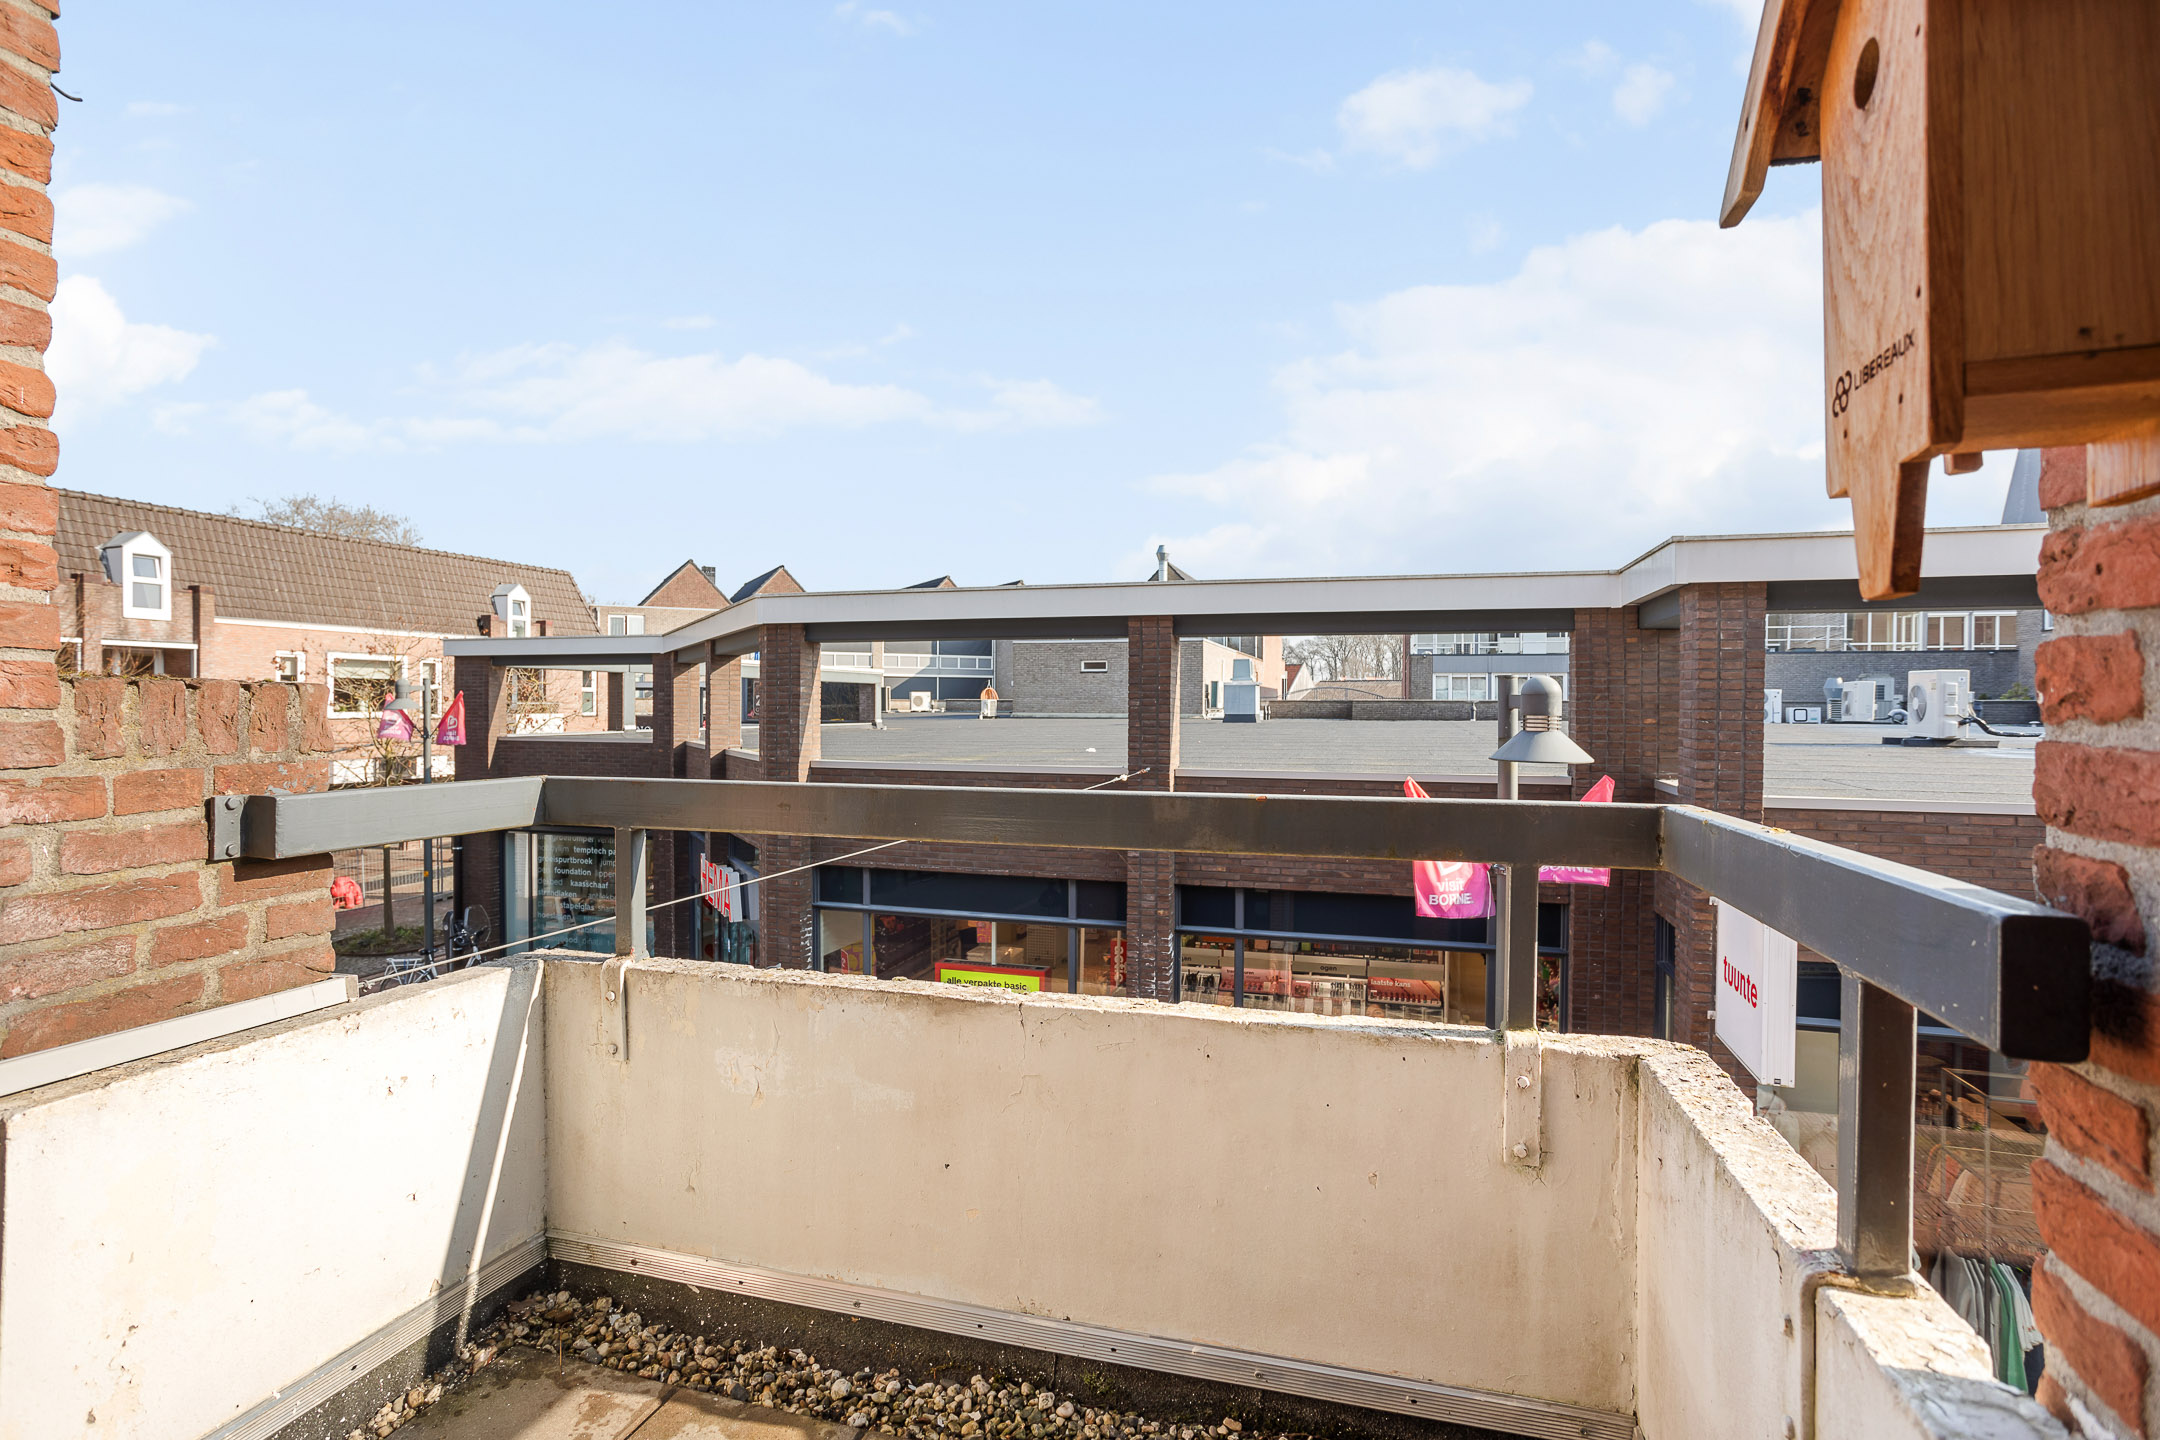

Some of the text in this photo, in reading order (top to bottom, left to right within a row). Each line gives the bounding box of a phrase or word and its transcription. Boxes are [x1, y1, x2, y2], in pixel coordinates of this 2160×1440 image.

[1853, 329, 1915, 391] LIBEREAUX
[573, 845, 607, 856] temptech
[554, 866, 592, 876] foundation
[570, 879, 609, 889] kaasschaaf
[700, 853, 733, 922] HEMA
[1437, 878, 1464, 892] visit
[560, 902, 595, 912] stapelglas
[946, 976, 1027, 991] alle verpakte basic
[1370, 979, 1411, 988] laatste kans
[1723, 956, 1758, 1009] tuunte
